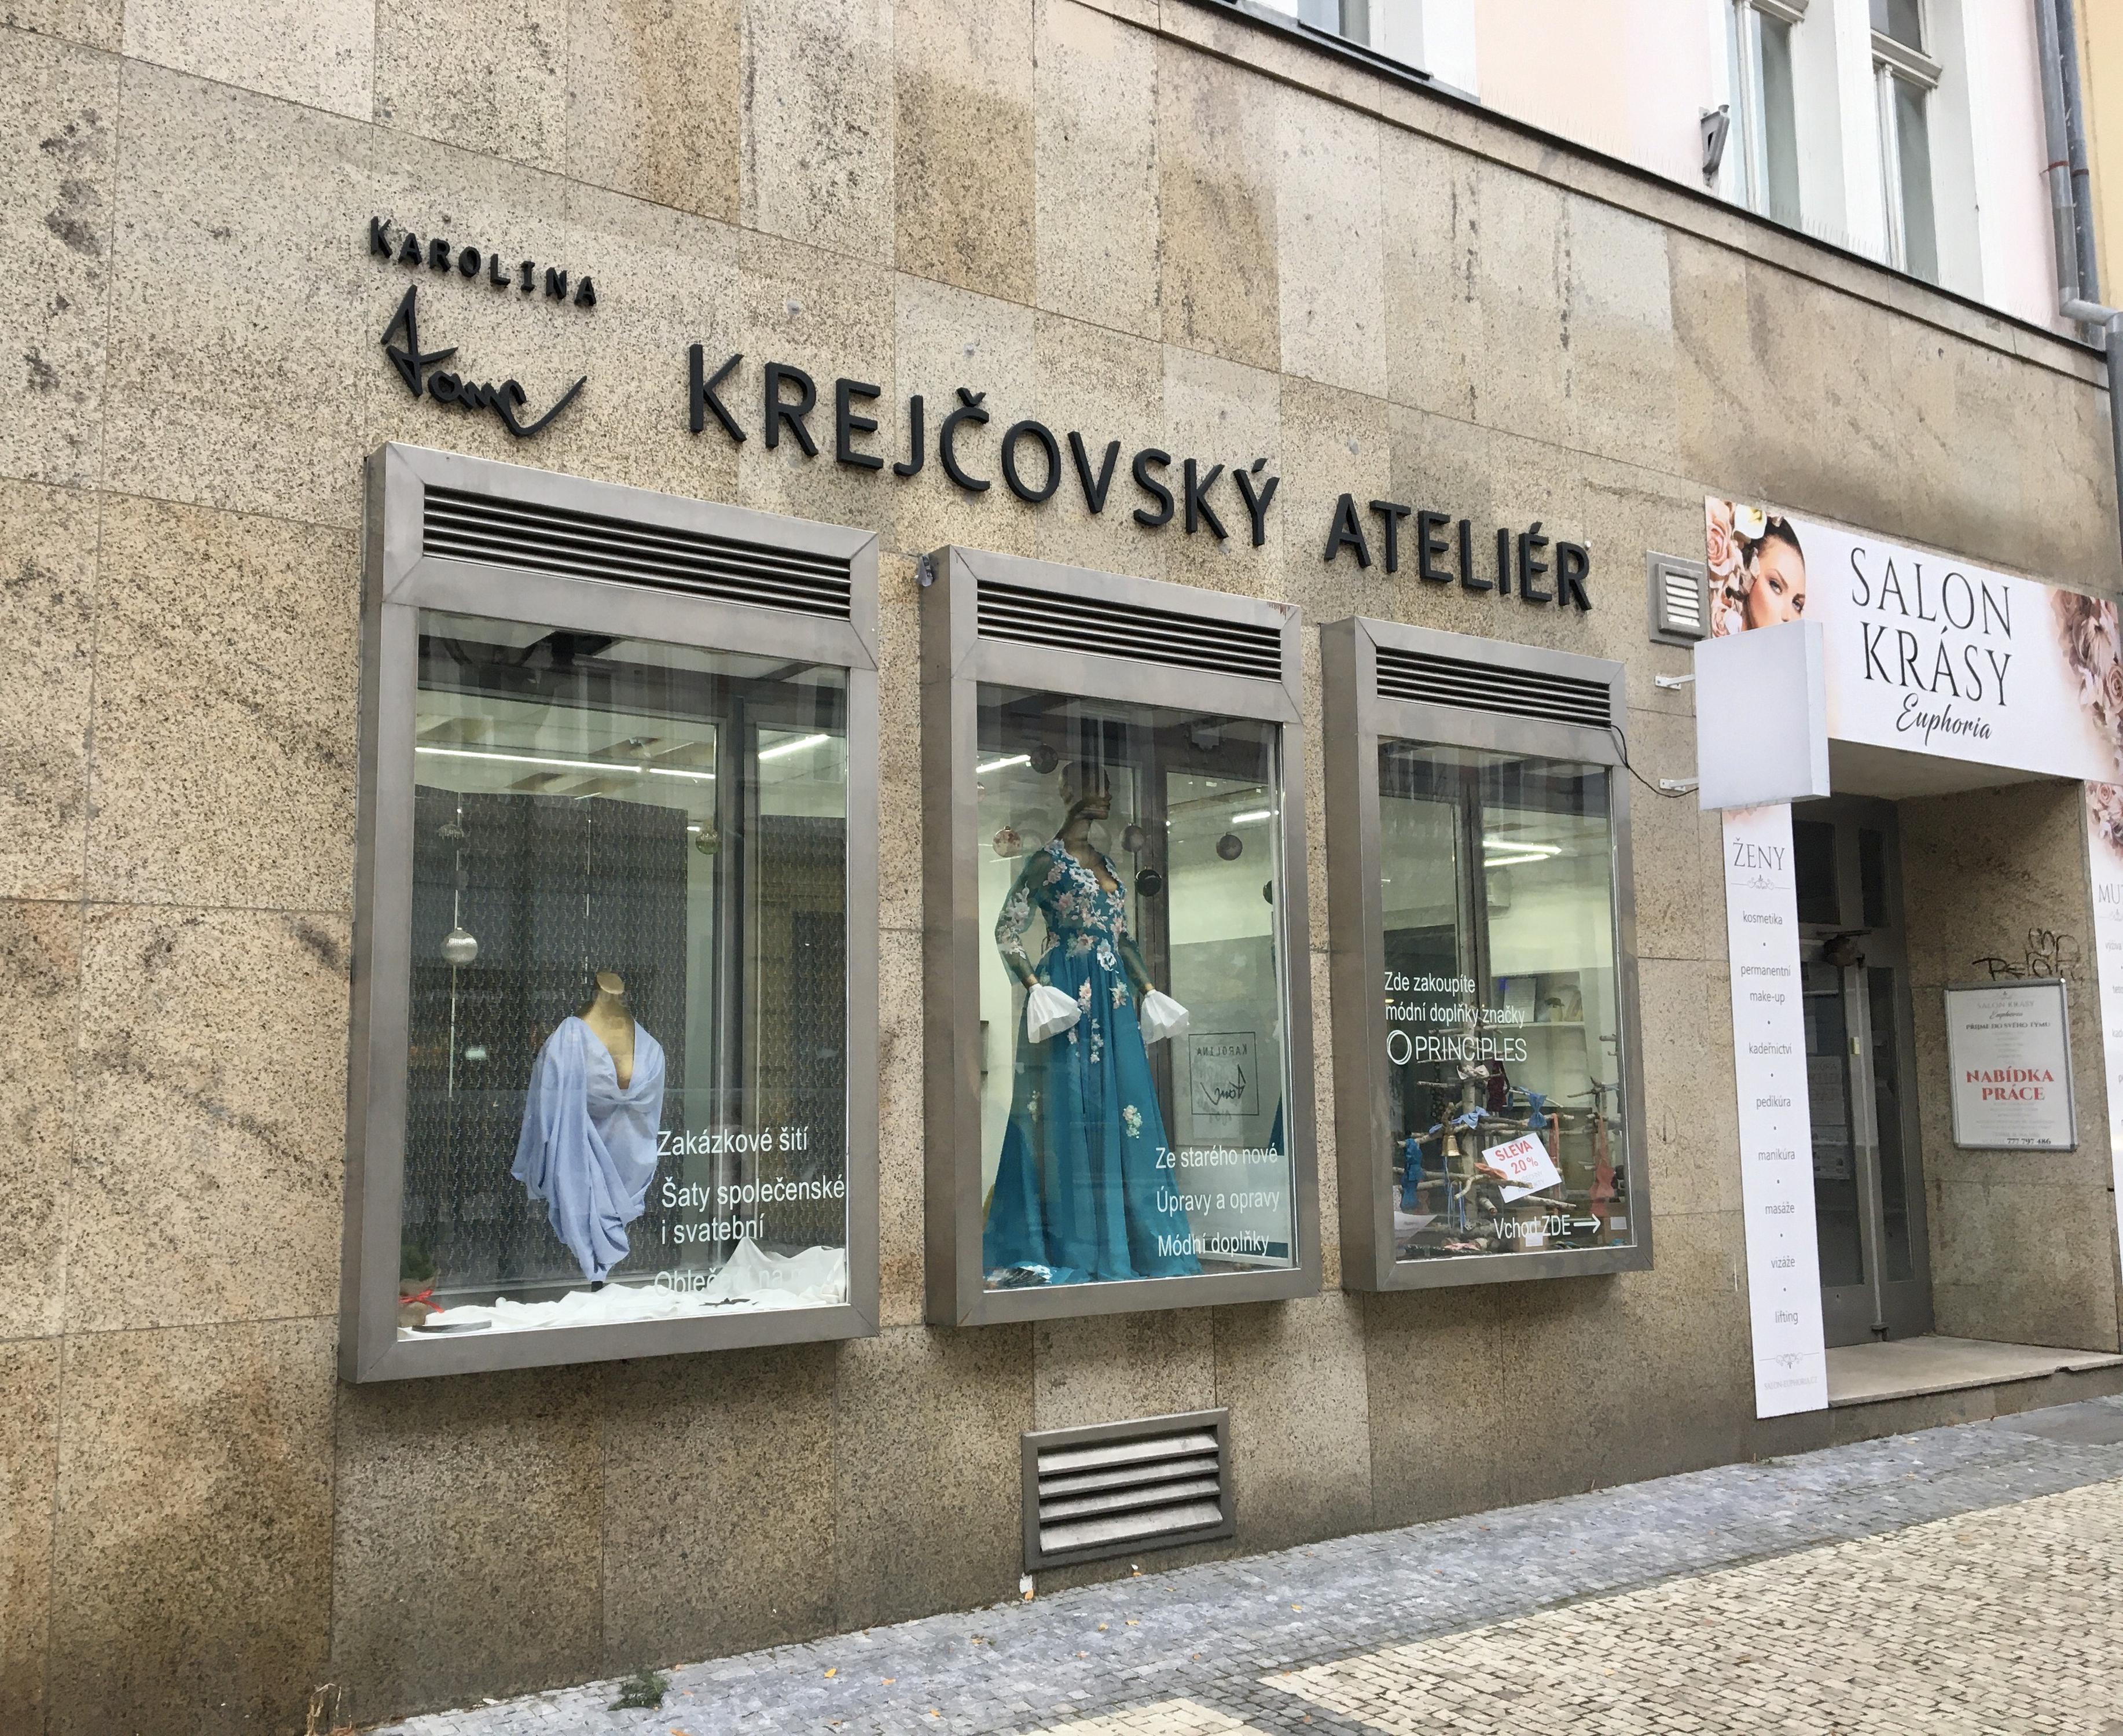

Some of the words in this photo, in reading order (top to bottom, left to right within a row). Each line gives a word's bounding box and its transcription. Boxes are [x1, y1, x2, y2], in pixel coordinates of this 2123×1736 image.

[369, 216, 597, 307] KAROLINA
[689, 343, 1280, 546] KREJČOVSKÝ
[1324, 493, 1593, 611] ATELIÉR
[1850, 546, 2012, 640] SALON
[1860, 621, 2012, 707] KRÁSY
[1896, 692, 1993, 746] Euphoria
[1732, 837, 1786, 871] ŽENY
[2099, 882, 2123, 905] MU
[1742, 910, 1783, 926] kosmetika
[1740, 964, 1791, 977] permanentní
[1384, 971, 1410, 992] Zde
[1413, 972, 1476, 997] zakoupíte
[1749, 990, 1786, 1003] make-up
[1385, 1001, 1427, 1021] módní
[1429, 1003, 1479, 1028] doplňky
[1482, 1005, 1526, 1029] značky
[1749, 1042, 1793, 1055] kadeřnictví
[1966, 1065, 2054, 1084] NABÍDKA
[1756, 1095, 1791, 1109] pedikúra
[1981, 1083, 2045, 1101] PRÁCE
[656, 1127, 773, 1156] Zakázkové
[779, 1126, 809, 1152] šití
[1494, 1139, 1534, 1161] SLEVA
[1155, 1146, 1176, 1169] Ze
[1180, 1145, 1238, 1168] starého
[1242, 1142, 1278, 1164] nové
[1757, 1149, 1795, 1161] manikúra
[661, 1176, 711, 1213] Šaty
[717, 1174, 846, 1211] společenské
[1156, 1186, 1211, 1218] Úpravy
[1216, 1193, 1226, 1211] a
[1229, 1189, 1280, 1214] opravy
[1765, 1201, 1795, 1215] masáže
[661, 1219, 666, 1245] i
[673, 1213, 766, 1244] svatební
[1493, 1216, 1538, 1240] Vchod
[1541, 1214, 1572, 1237] ZDE
[1158, 1233, 1206, 1258] Módní
[1211, 1230, 1269, 1257] doplňky
[1770, 1256, 1795, 1269] vizáže
[1775, 1310, 1799, 1325] lifting
